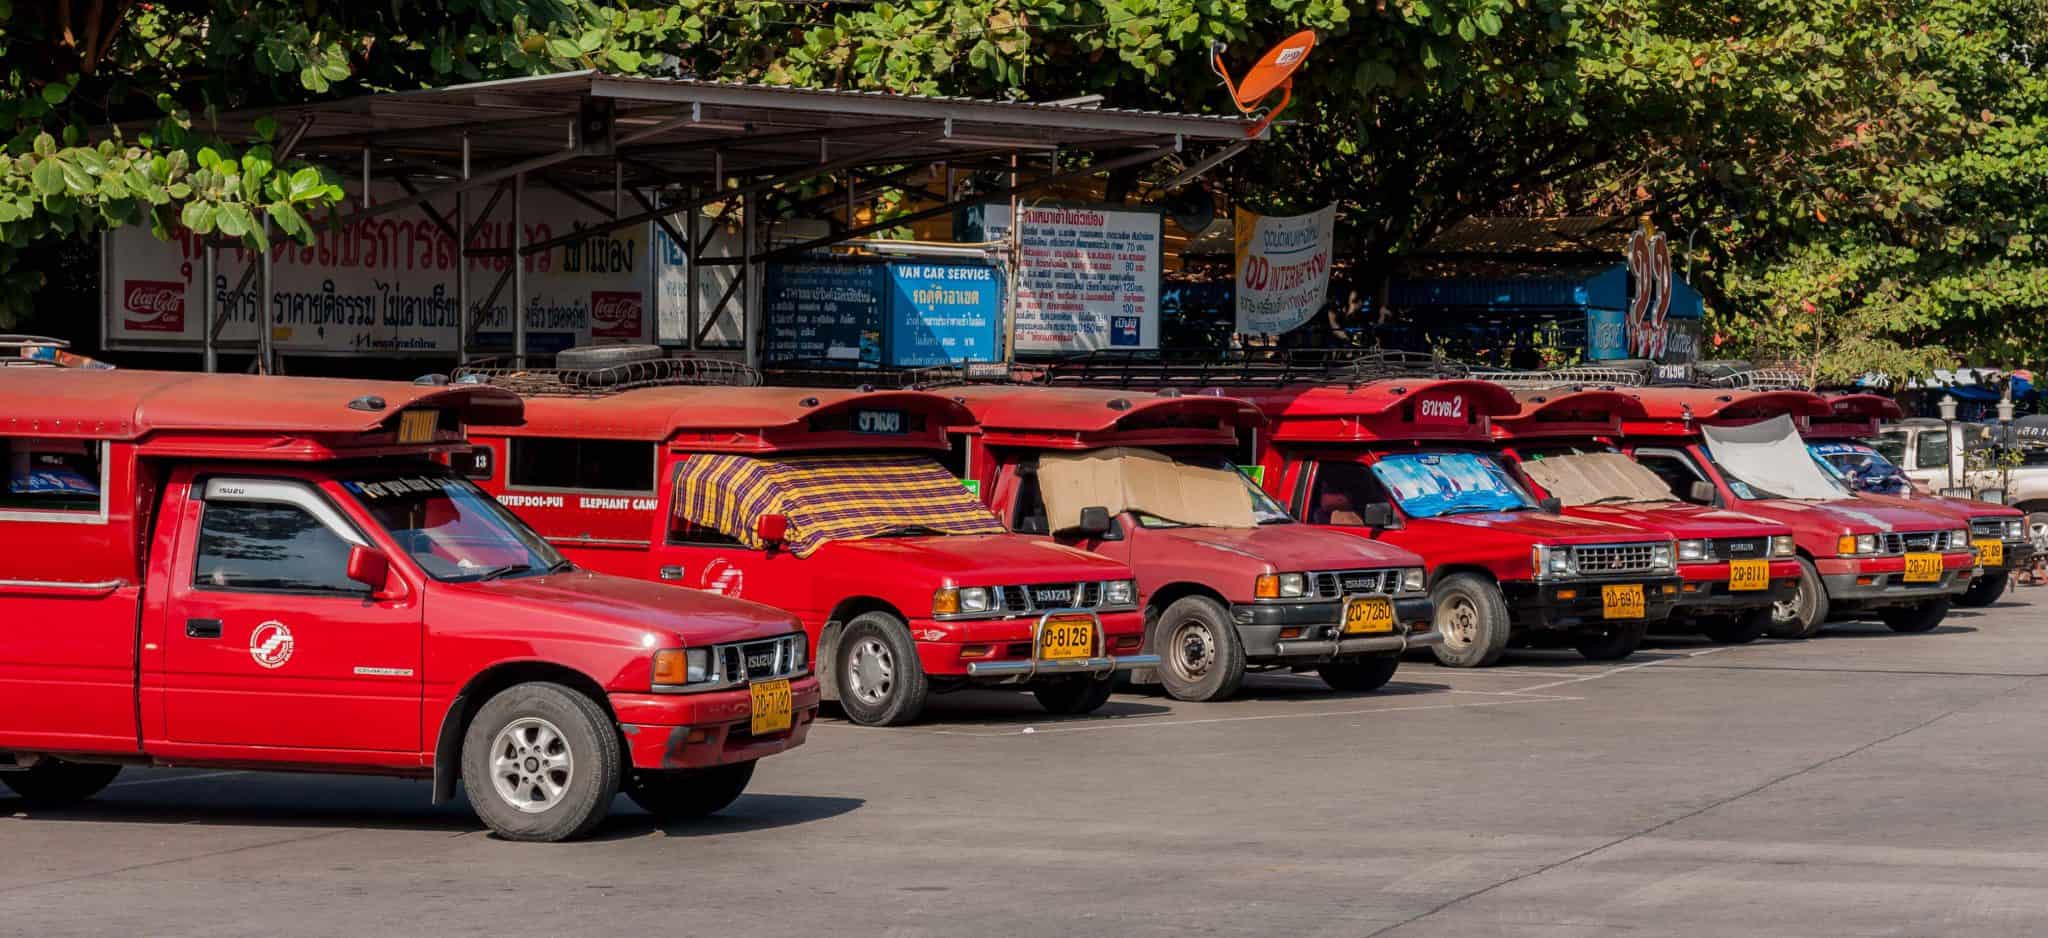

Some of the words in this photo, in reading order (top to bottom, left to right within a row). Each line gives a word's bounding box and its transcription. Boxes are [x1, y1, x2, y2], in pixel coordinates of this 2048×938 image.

[899, 266, 920, 278] VAN
[923, 267, 945, 280] CAR
[947, 268, 991, 281] SERVICE
[374, 279, 460, 327] ไม่เอาเปรีย
[1422, 399, 1452, 416] อาเขต
[1452, 394, 1462, 418] 2
[474, 455, 487, 468] 13
[580, 496, 629, 509] ELEPHANT
[1036, 589, 1071, 602] ISUZU
[748, 653, 773, 668] ISUZU
